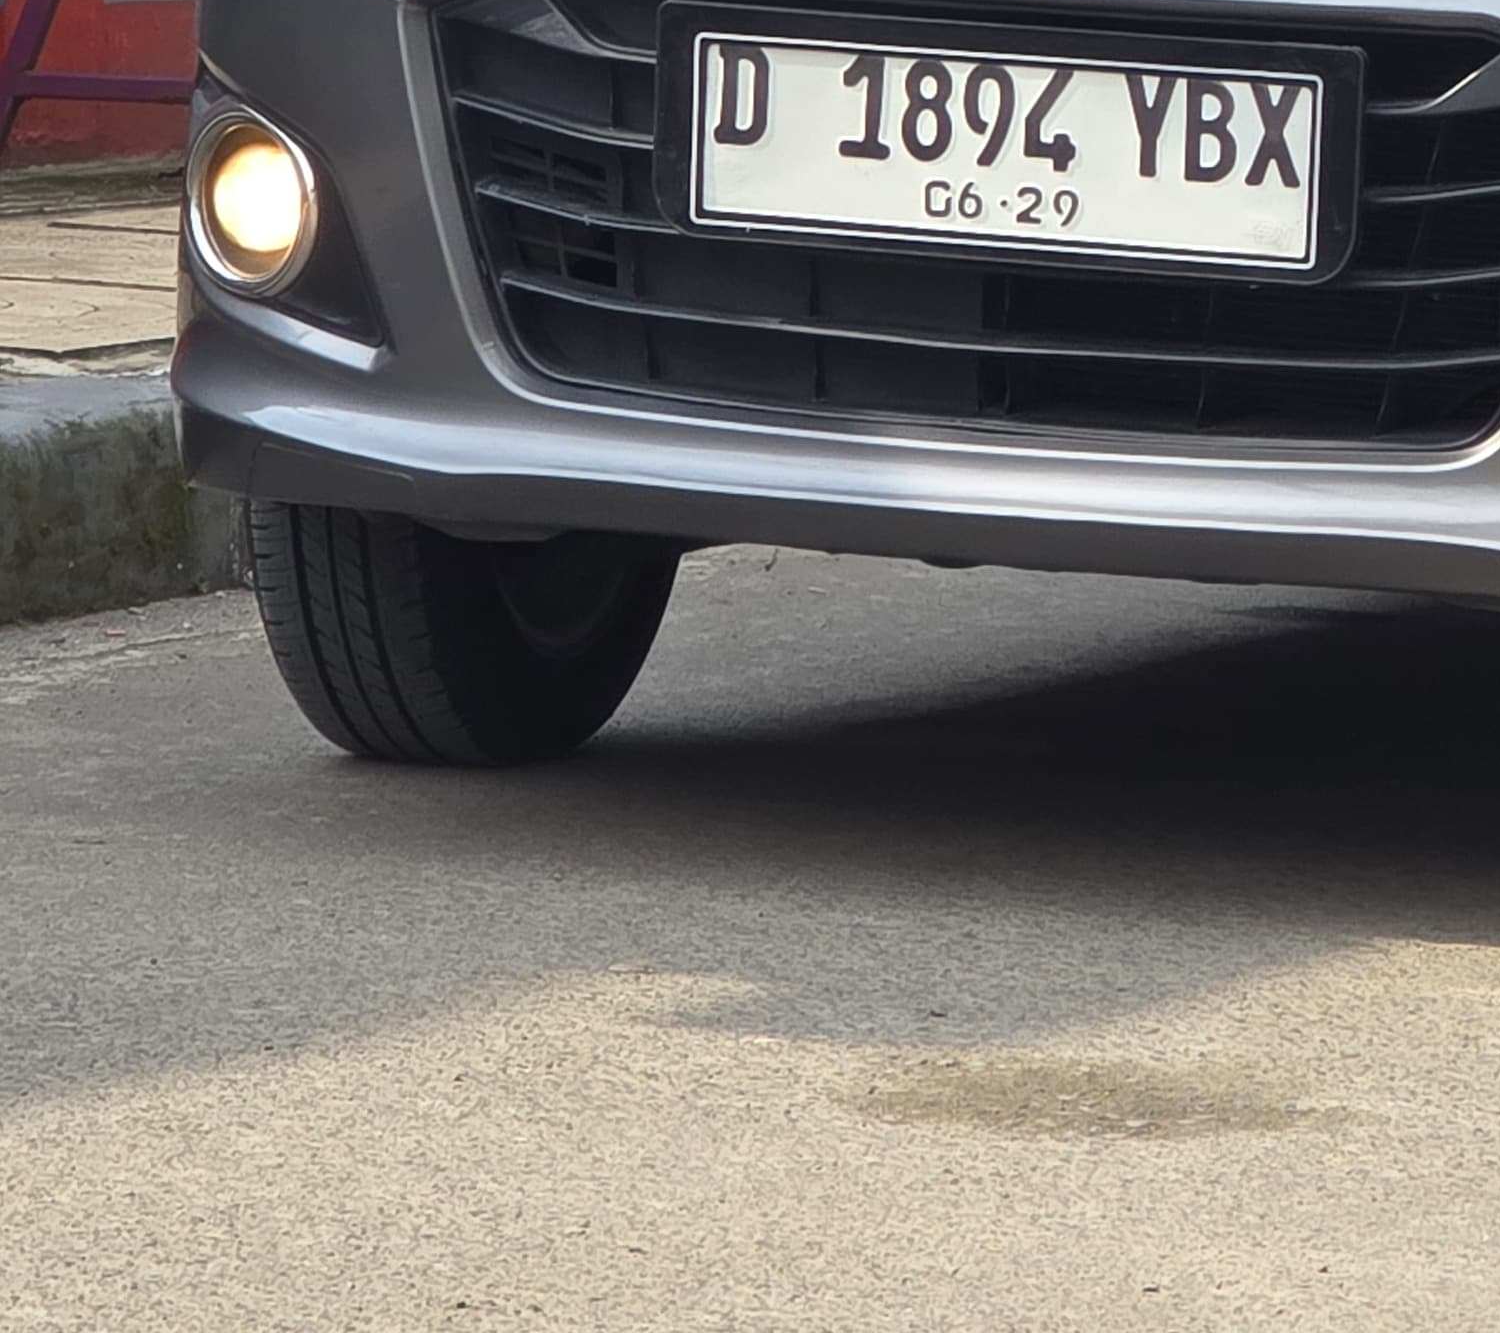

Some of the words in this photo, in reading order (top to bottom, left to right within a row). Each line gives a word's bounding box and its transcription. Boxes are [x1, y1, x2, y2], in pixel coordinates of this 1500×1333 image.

[713, 44, 770, 146] D
[838, 53, 1077, 173] 1894
[1125, 73, 1302, 189] YBX
